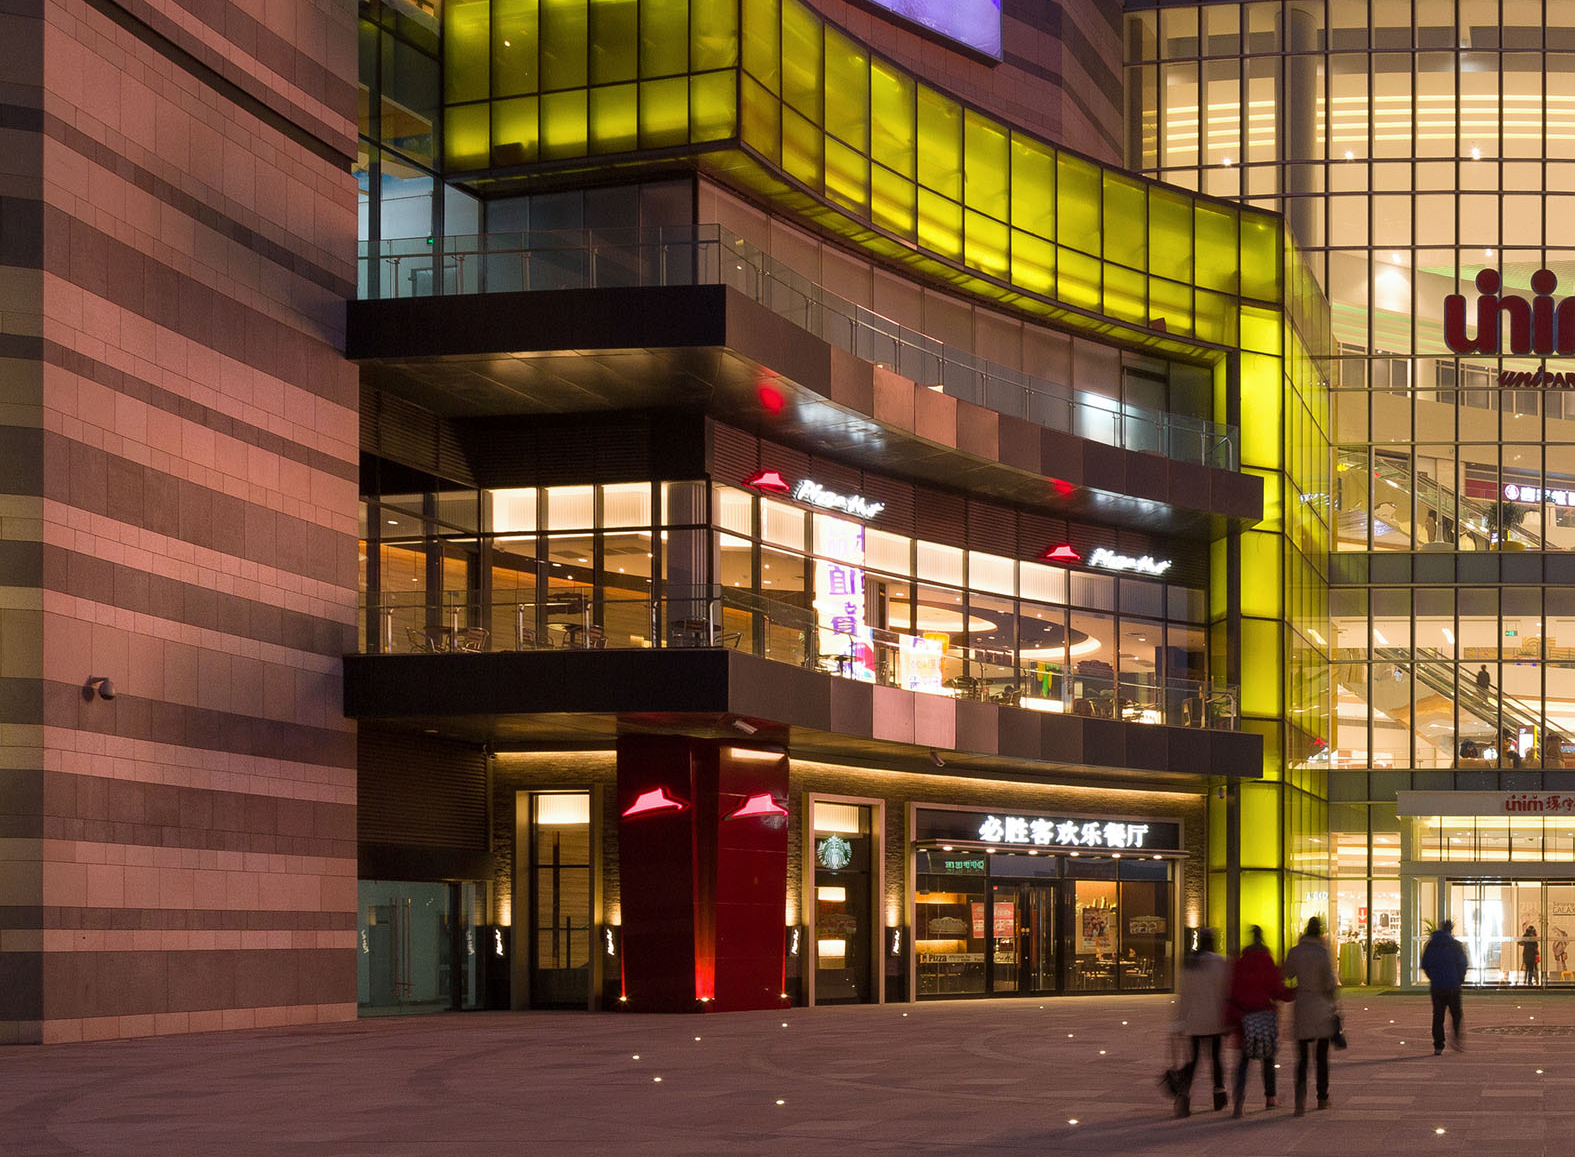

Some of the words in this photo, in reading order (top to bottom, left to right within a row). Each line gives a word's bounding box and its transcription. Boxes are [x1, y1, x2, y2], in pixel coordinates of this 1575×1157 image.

[796, 479, 847, 508] Pizza
[846, 494, 885, 519] Hut
[979, 815, 1149, 848] 必胜客欢乐餐厅
